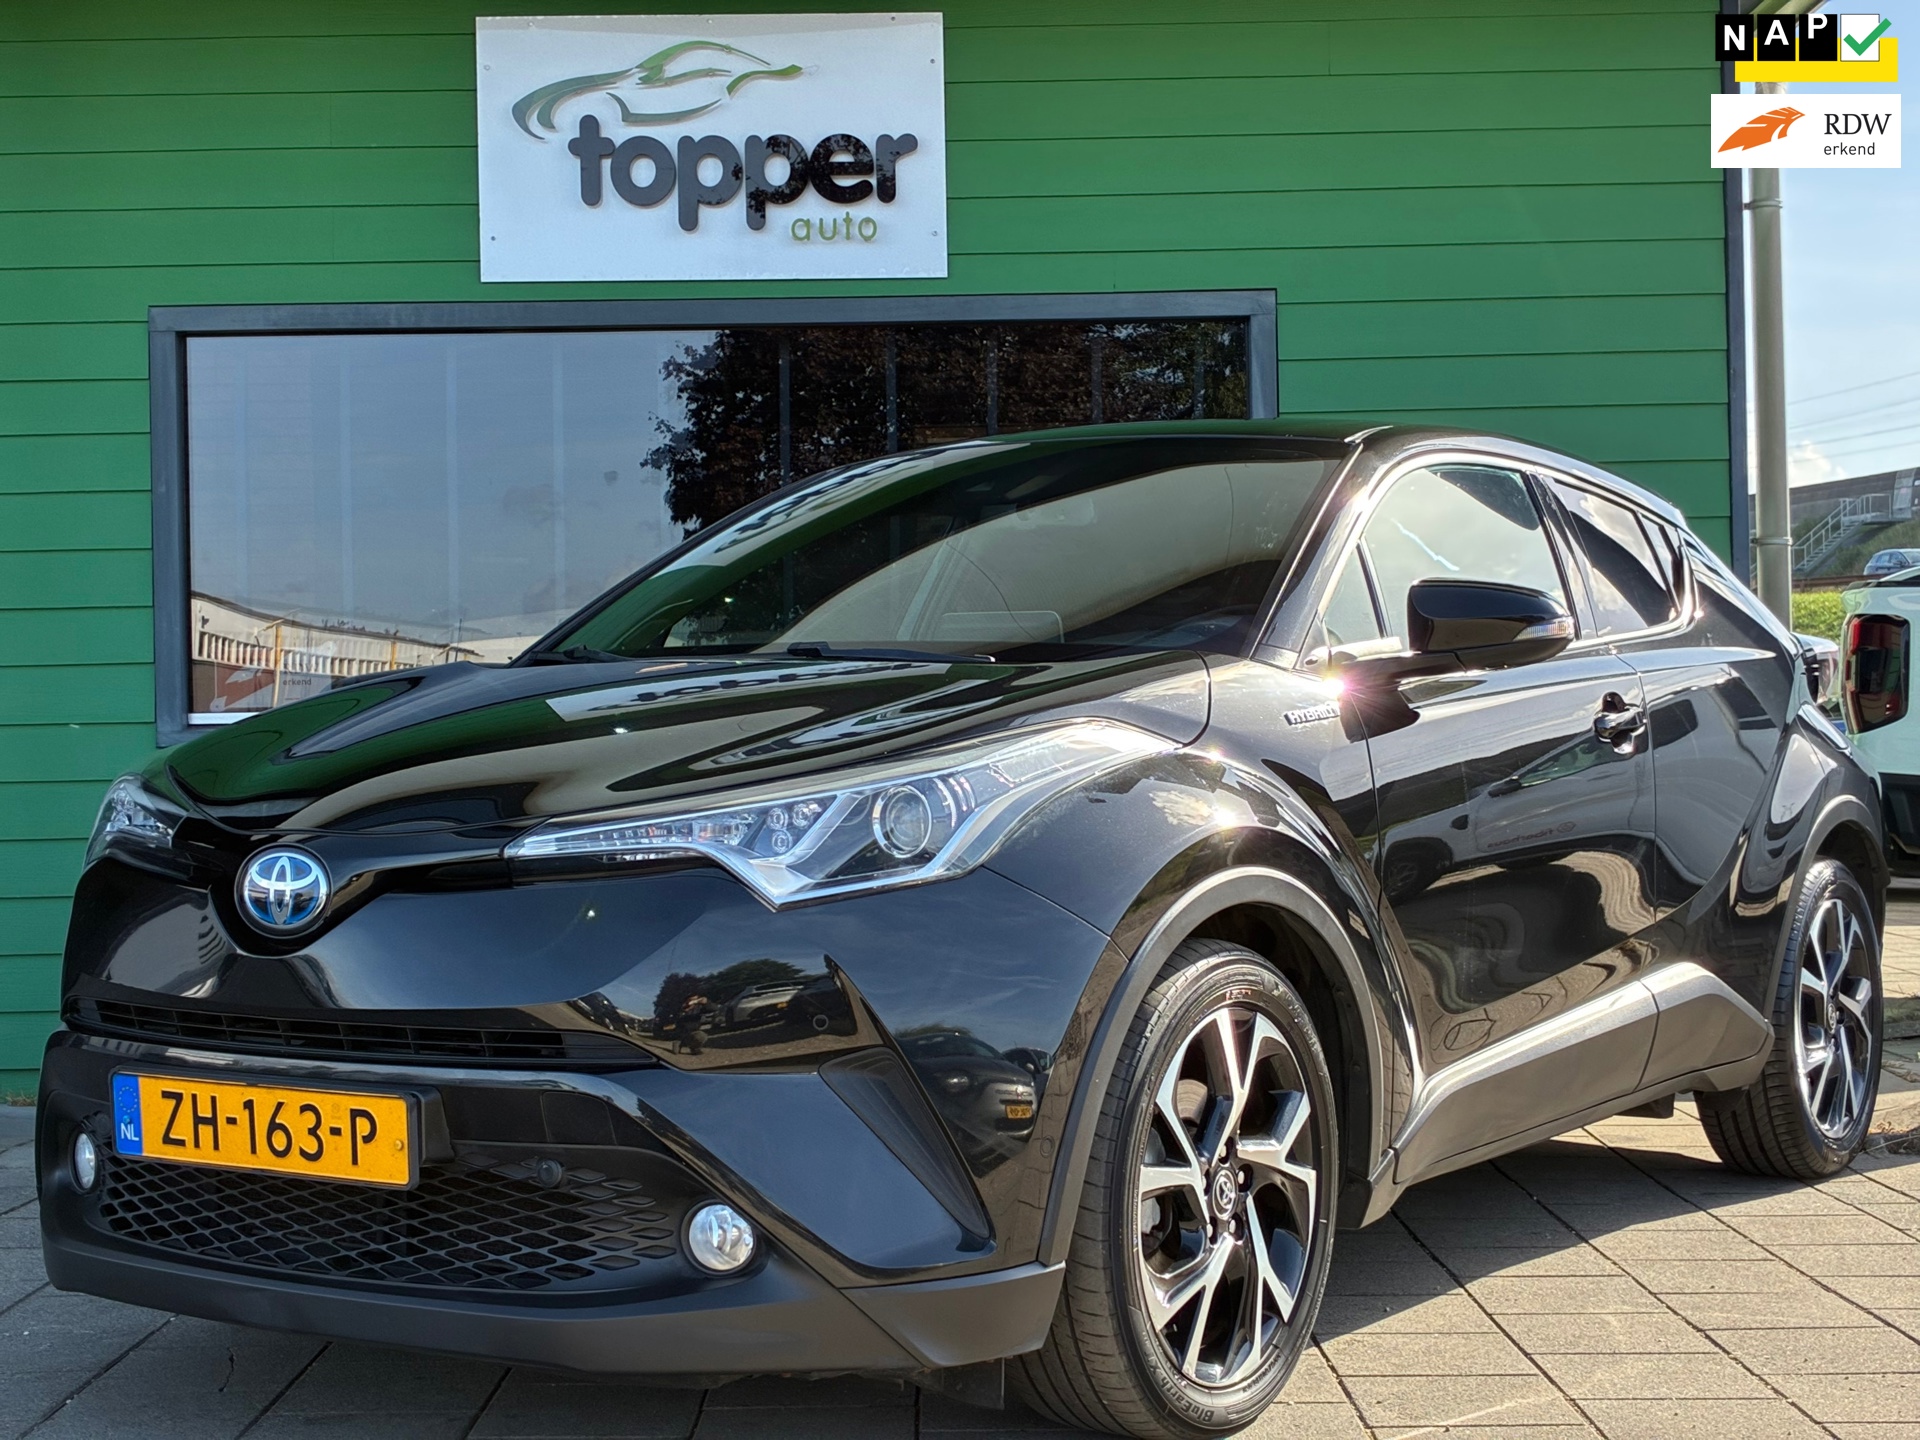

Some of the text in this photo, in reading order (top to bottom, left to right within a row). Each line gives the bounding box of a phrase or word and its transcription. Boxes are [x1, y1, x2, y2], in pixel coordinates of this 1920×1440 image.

[567, 114, 919, 232] topper
[790, 211, 878, 242] auto
[282, 678, 312, 686] erkend
[1286, 702, 1340, 725] HYBRID
[119, 1121, 140, 1142] NL
[160, 1090, 378, 1166] ZH-163-P
